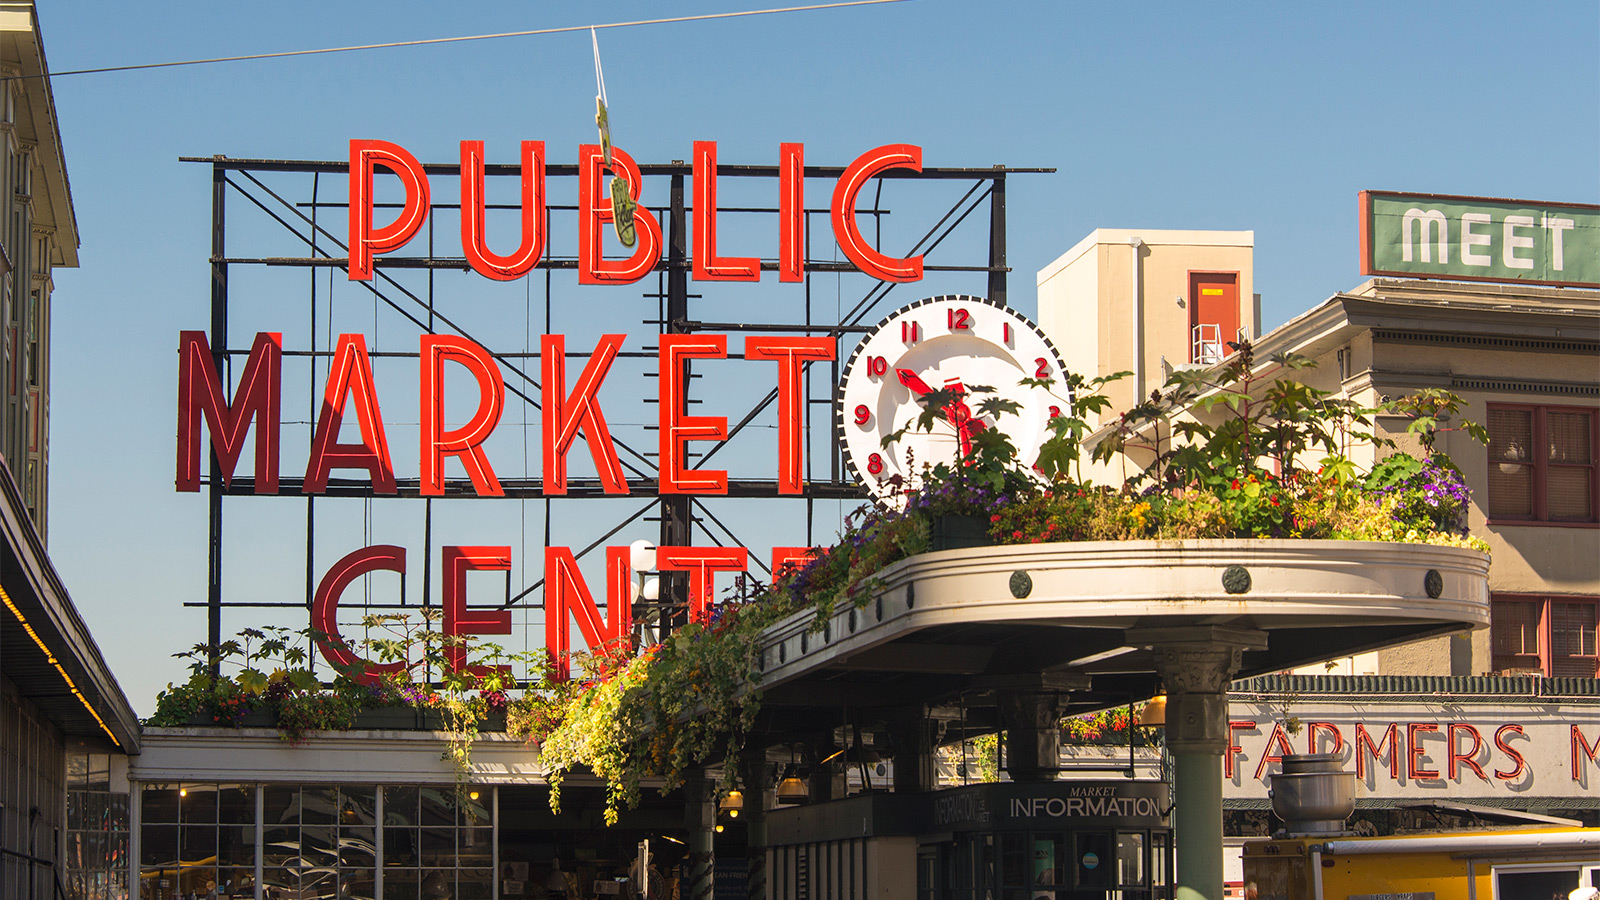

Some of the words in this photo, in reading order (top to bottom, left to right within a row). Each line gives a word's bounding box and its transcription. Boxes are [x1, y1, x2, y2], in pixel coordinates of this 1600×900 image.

[348, 139, 924, 285] PUBLIC
[1402, 208, 1575, 272] MEET
[947, 308, 970, 330] 12
[901, 321, 918, 343] 11
[1003, 322, 1009, 344] 1
[866, 356, 888, 377] 10
[1035, 357, 1049, 378] 2
[176, 331, 836, 496] MARKET
[854, 404, 870, 425] 9
[867, 452, 883, 475] 8
[312, 545, 829, 688] CENT
[1070, 787, 1117, 797] MARKET
[1010, 798, 1161, 818] INFORMATION
